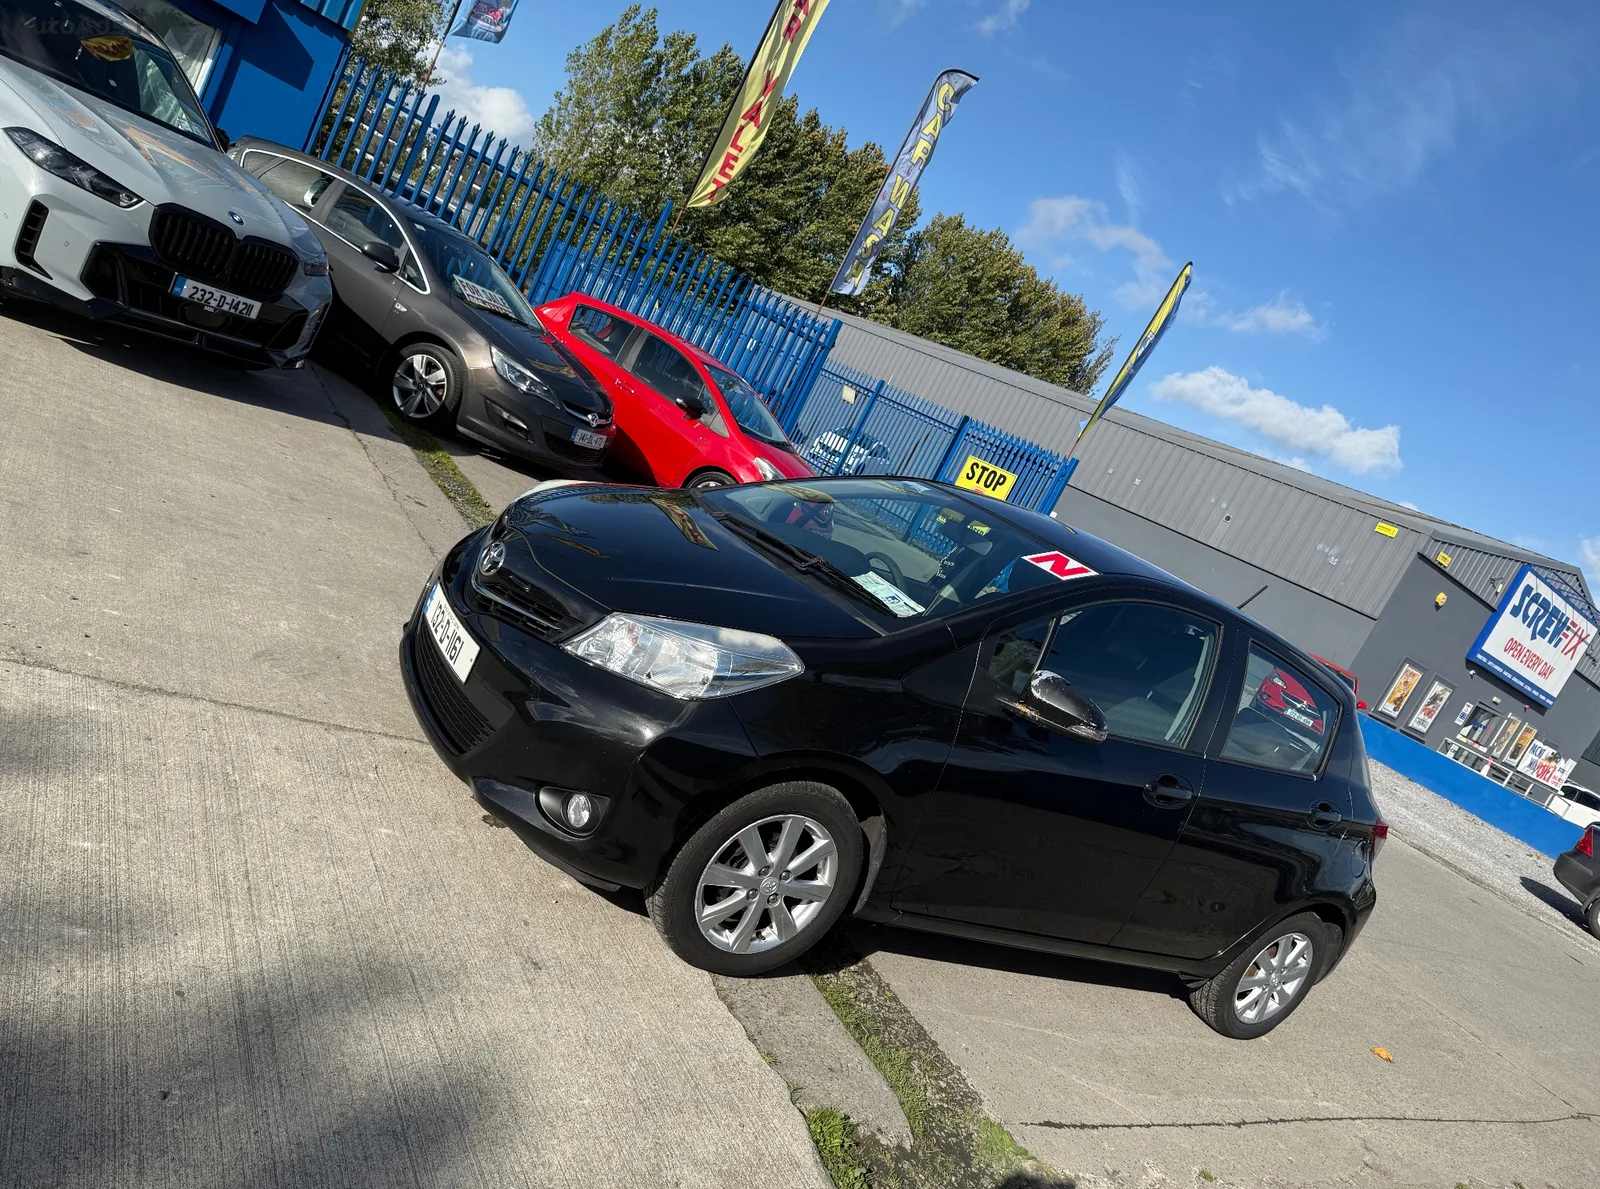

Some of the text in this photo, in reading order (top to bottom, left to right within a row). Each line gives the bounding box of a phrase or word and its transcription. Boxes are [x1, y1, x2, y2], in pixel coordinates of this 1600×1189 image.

[709, 69, 779, 200] VALET
[845, 82, 956, 288] CAR WASH
[188, 286, 254, 317] 232-D-14211
[459, 280, 484, 299] FOR
[965, 462, 1007, 491] STOP
[1029, 554, 1091, 577] N
[430, 600, 465, 665] 132-D-1161
[1509, 584, 1590, 660] SCREWFIX
[1503, 637, 1526, 661] OPEN
[1520, 648, 1544, 673] EVERY
[1537, 661, 1556, 680] DAY
